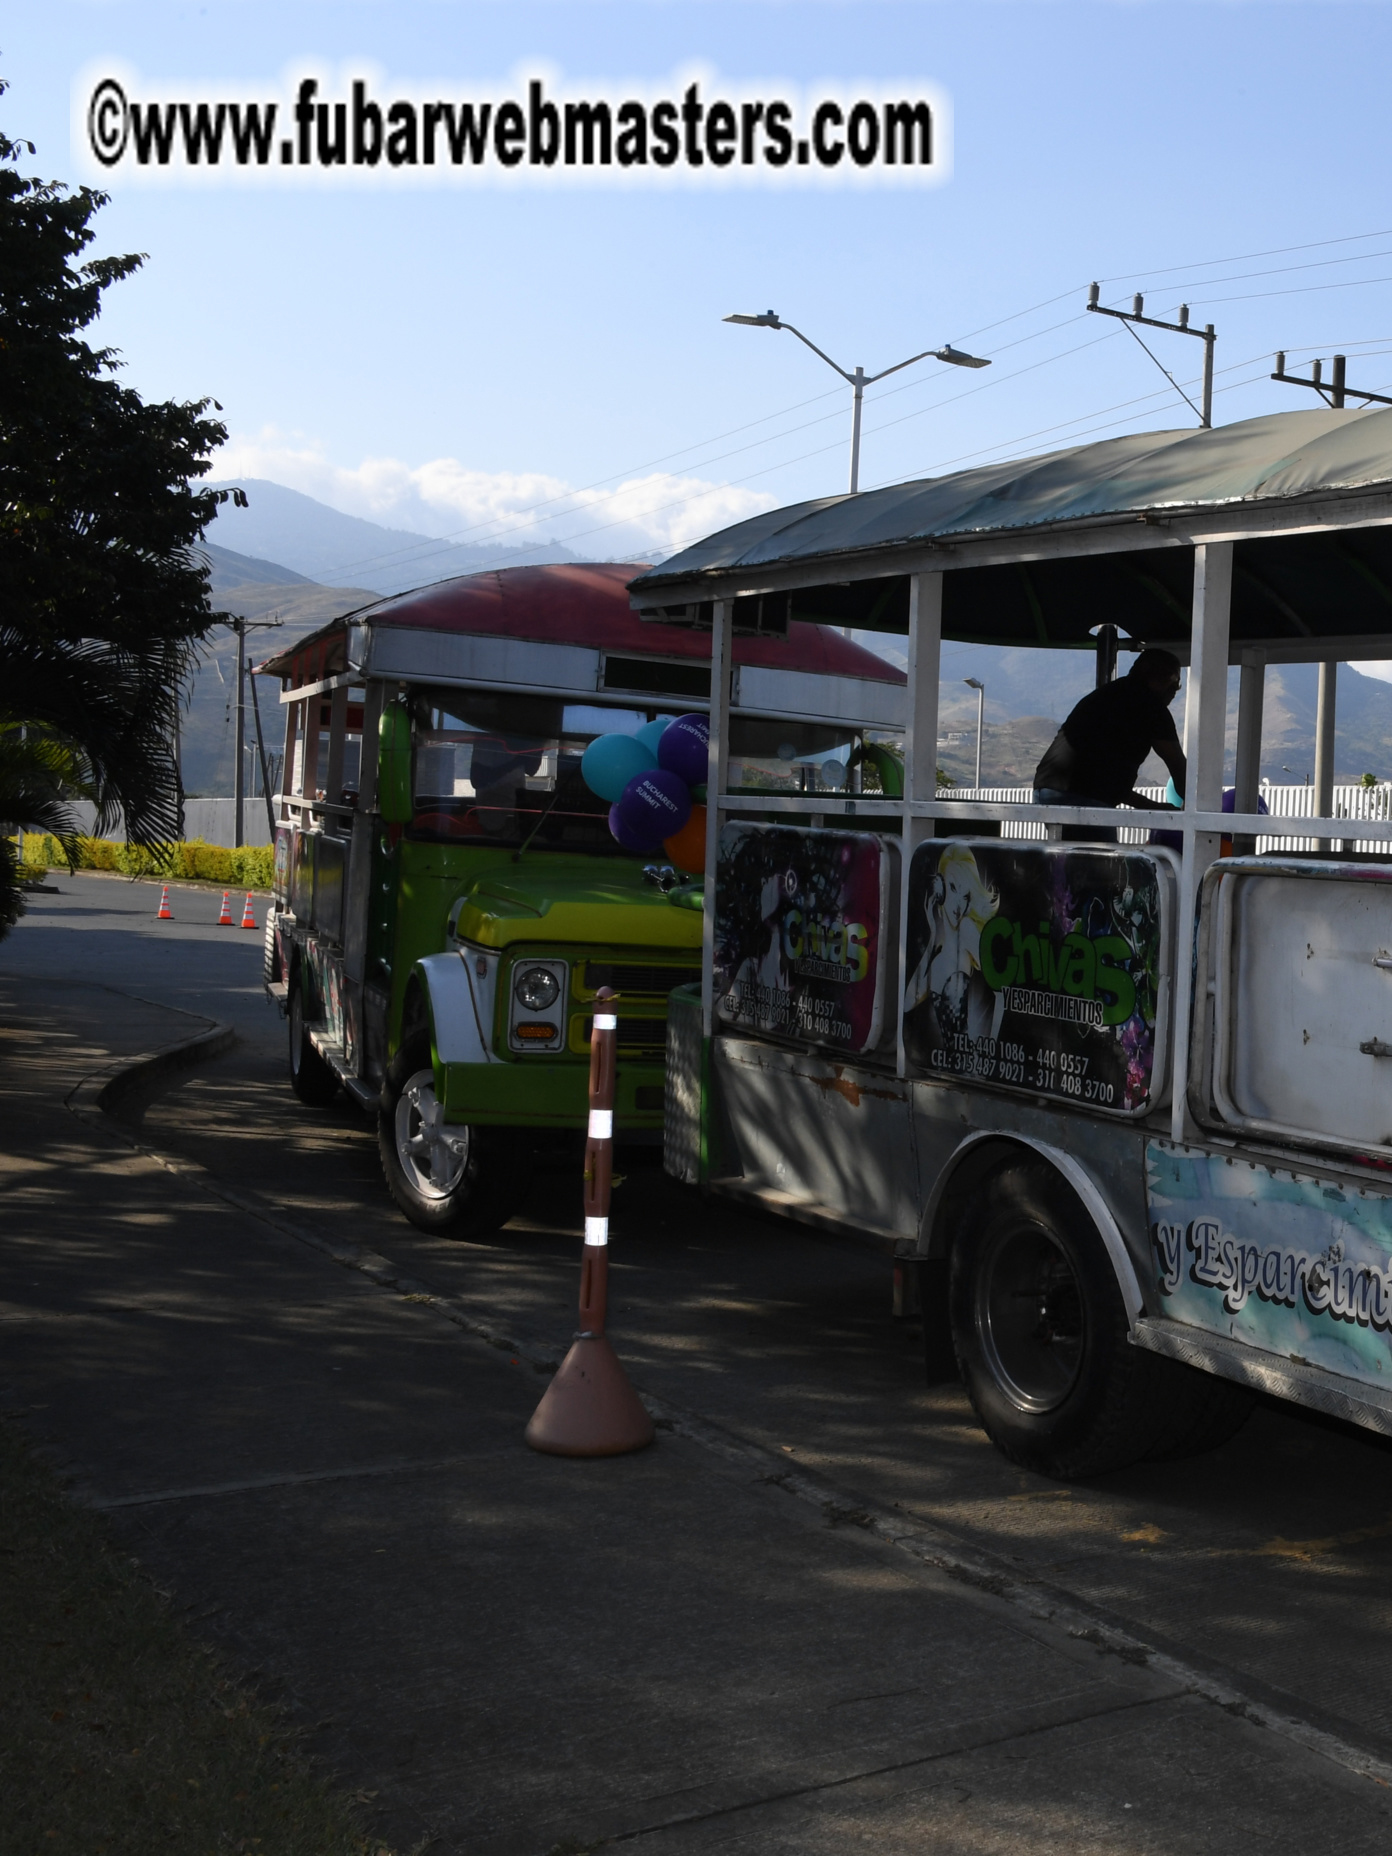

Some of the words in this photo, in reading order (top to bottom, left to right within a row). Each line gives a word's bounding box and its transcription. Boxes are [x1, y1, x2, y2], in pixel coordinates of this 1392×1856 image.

[635, 786, 661, 809] SUMMIT
[643, 780, 678, 813] BUCHAREST
[740, 982, 755, 999] TEL:
[757, 986, 770, 1002] 440
[772, 988, 791, 1007] 1086
[798, 996, 813, 1013] 440
[815, 999, 835, 1017] 0557
[1002, 986, 1010, 1010] Y
[1011, 988, 1103, 1027] ESPARCIMIENTOS
[771, 1006, 790, 1025] 9021
[798, 1012, 812, 1030] 310
[815, 1016, 830, 1035] 408
[832, 1021, 852, 1040] 3700
[953, 1033, 974, 1051] TEL:
[976, 1037, 996, 1057] 440
[1000, 1041, 1025, 1063] 1086
[1036, 1049, 1057, 1069] 440
[1060, 1053, 1089, 1075] 0557
[931, 1049, 951, 1068] CEL:
[955, 1053, 974, 1073] 315
[976, 1057, 996, 1077] 487
[999, 1062, 1025, 1083] 9021
[1061, 1074, 1082, 1095] 408
[1085, 1079, 1114, 1103] 3700
[1155, 1219, 1185, 1295] y
